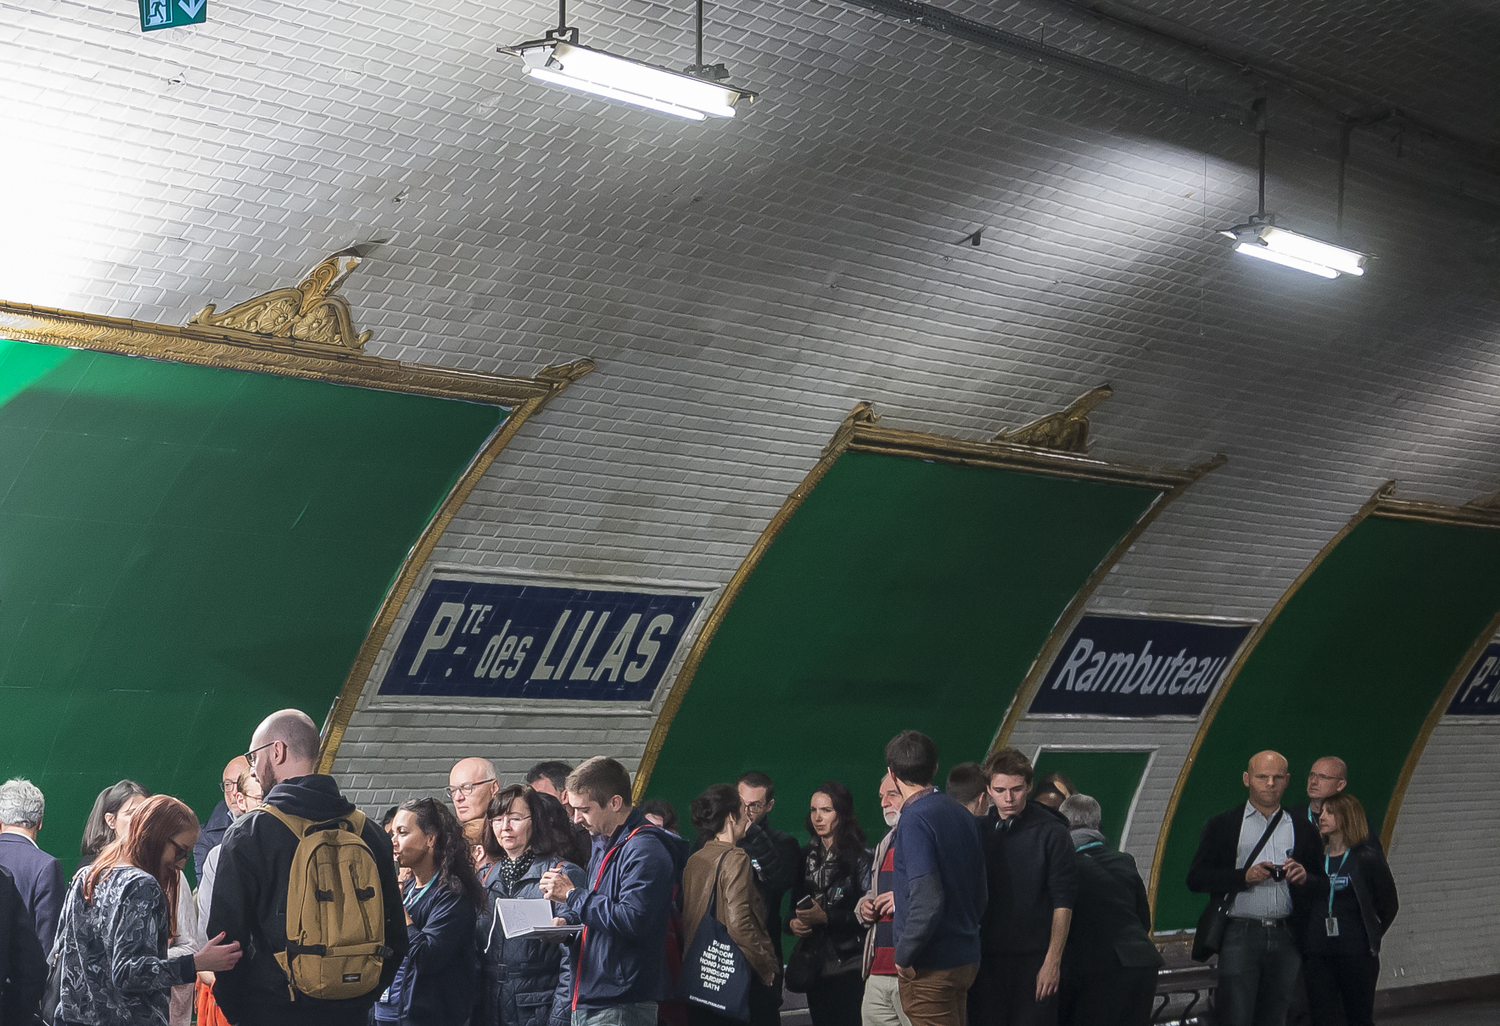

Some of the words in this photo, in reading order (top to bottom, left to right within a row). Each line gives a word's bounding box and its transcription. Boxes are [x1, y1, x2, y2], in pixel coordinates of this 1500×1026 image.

[474, 620, 533, 679] des
[530, 610, 674, 682] LILAS
[1052, 639, 1227, 695] Rambuteau
[707, 945, 733, 959] LONDON
[712, 939, 731, 951] PARIS
[699, 957, 718, 968] HONG
[717, 962, 735, 974] KONG
[702, 951, 718, 961] NEW
[717, 956, 735, 966] YORK
[700, 966, 730, 980] WINDSOR
[700, 973, 727, 985] CARDIFF
[703, 981, 720, 992] BATH
